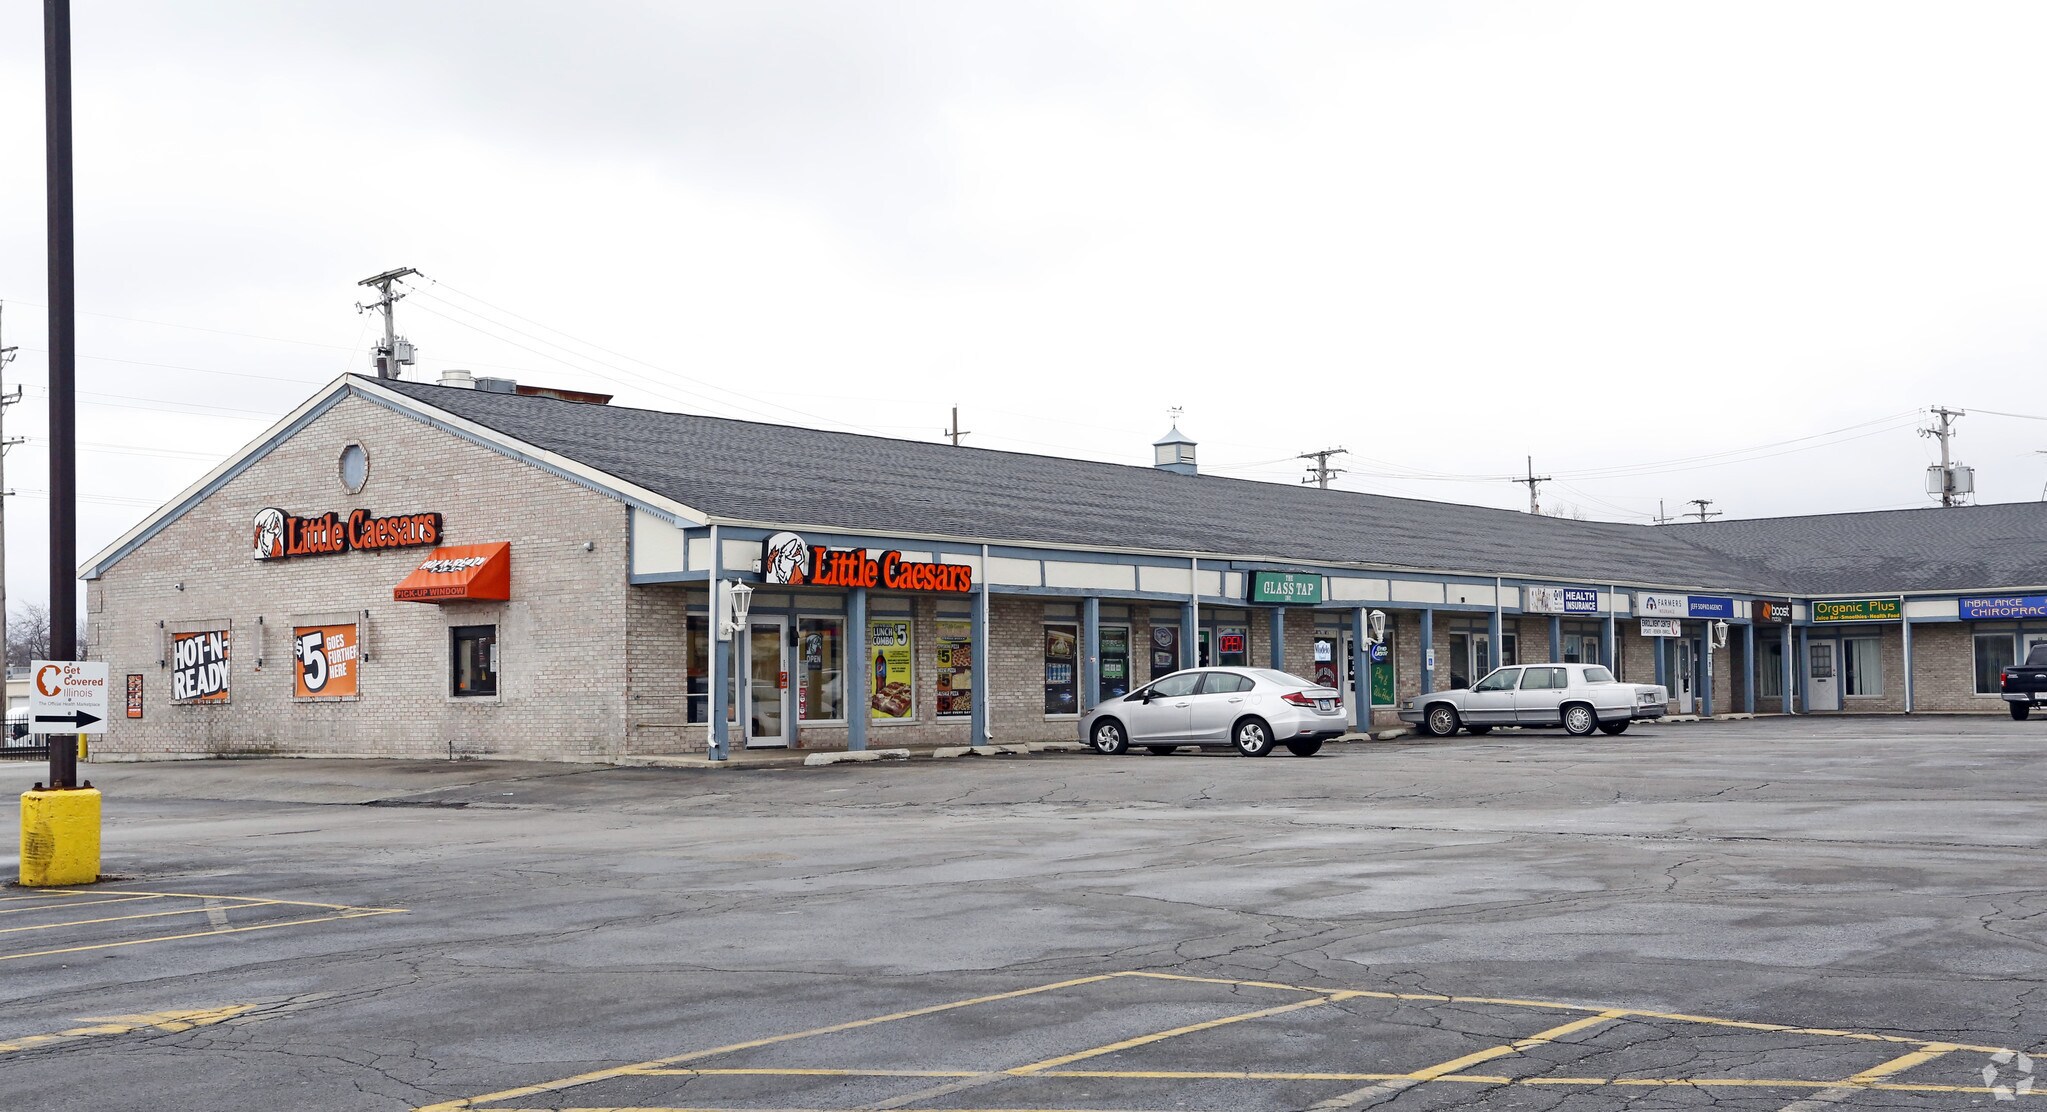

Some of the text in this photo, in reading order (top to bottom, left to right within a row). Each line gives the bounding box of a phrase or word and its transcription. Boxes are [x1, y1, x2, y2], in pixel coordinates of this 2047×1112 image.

[286, 509, 437, 555] Little Caesars
[812, 546, 972, 593] Little Caesars
[1285, 574, 1294, 582] THE
[396, 587, 464, 598] PICK-UP WINDOW
[1263, 581, 1314, 596] GLASS TAP
[1565, 591, 1595, 600] HEALTH
[1566, 600, 1596, 611] INSURANCE
[1658, 598, 1682, 608] FARMERS
[1817, 600, 1895, 616] Organic Plus
[1964, 598, 2023, 608] INBALANCE
[1771, 604, 1790, 617] boost
[1970, 606, 2047, 617] CHIROPRAC
[1660, 620, 1671, 628] CENTER
[873, 627, 893, 636] LUNCH
[326, 633, 345, 651] GOES
[872, 636, 894, 646] COMBO
[1220, 636, 1243, 652] OPEN
[296, 632, 327, 690] $5
[806, 654, 822, 663] OPEN
[64, 666, 80, 674] Get
[329, 662, 348, 680] HERE
[64, 678, 104, 686] Covered
[174, 660, 228, 700] READY
[64, 688, 93, 698] Illinois
